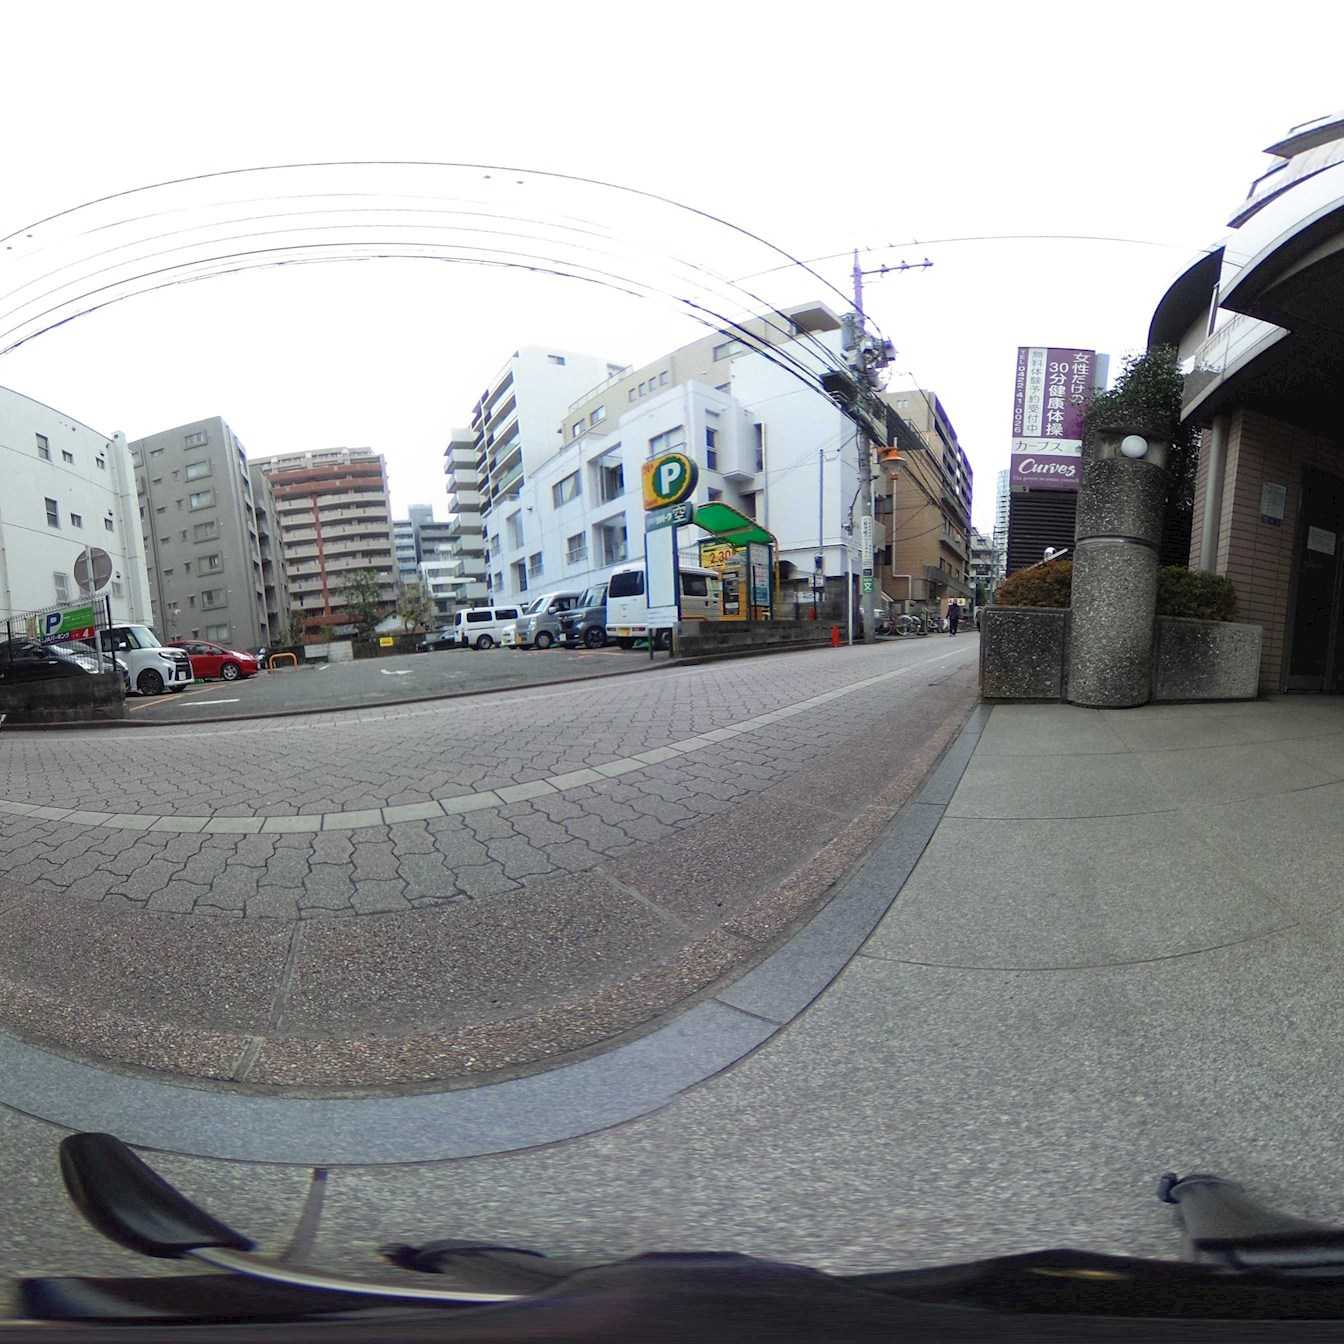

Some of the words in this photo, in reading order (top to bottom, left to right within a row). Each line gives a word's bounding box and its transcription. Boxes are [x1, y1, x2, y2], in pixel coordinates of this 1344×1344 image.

[1071, 353, 1090, 404] 女性だけの
[1045, 361, 1069, 436] 30分健康体操
[660, 462, 681, 495] P
[1018, 458, 1076, 478] Curves
[672, 504, 687, 524] 空
[46, 612, 61, 633] P
